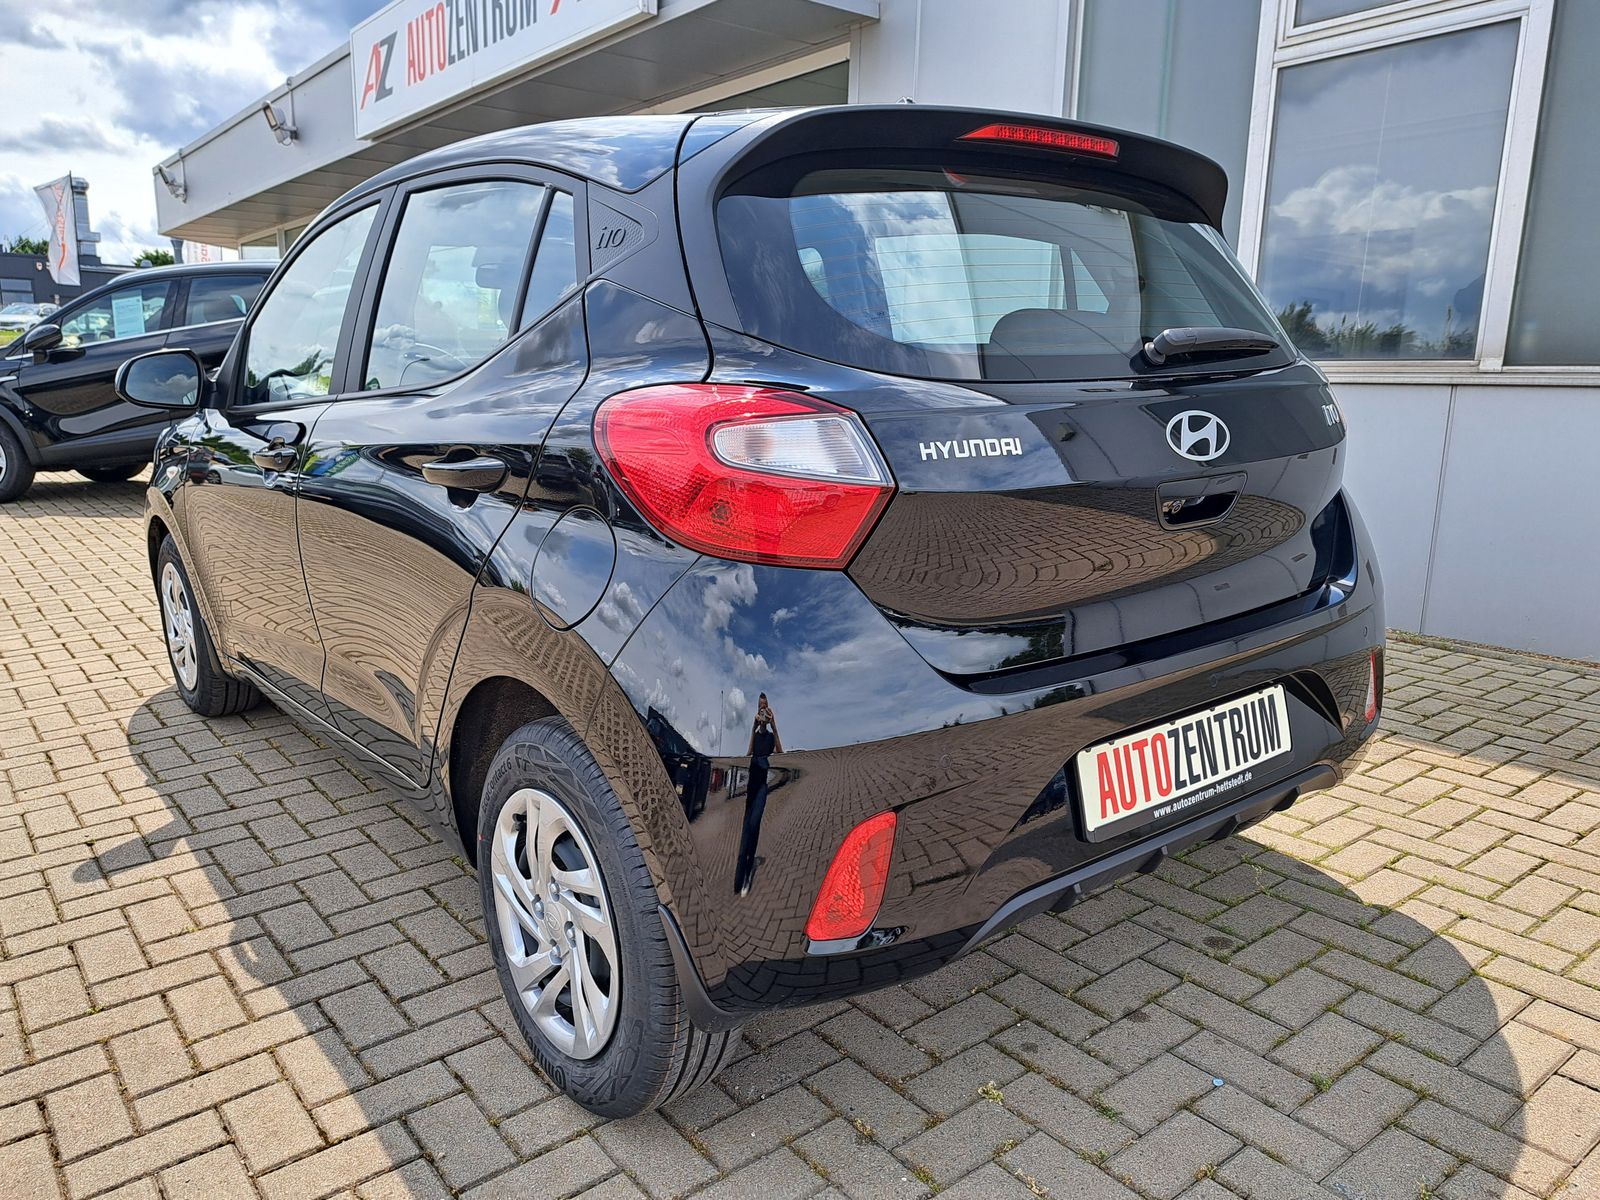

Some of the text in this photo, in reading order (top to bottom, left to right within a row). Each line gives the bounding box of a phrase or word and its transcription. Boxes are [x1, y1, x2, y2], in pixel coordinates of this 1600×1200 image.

[360, 30, 398, 111] AZ
[596, 226, 627, 250] i10
[919, 437, 1023, 461] HYUNDAI
[1097, 694, 1282, 819] AUTOZENTRUM
[1153, 771, 1253, 818] www.autozentrum-hettstedt.de
